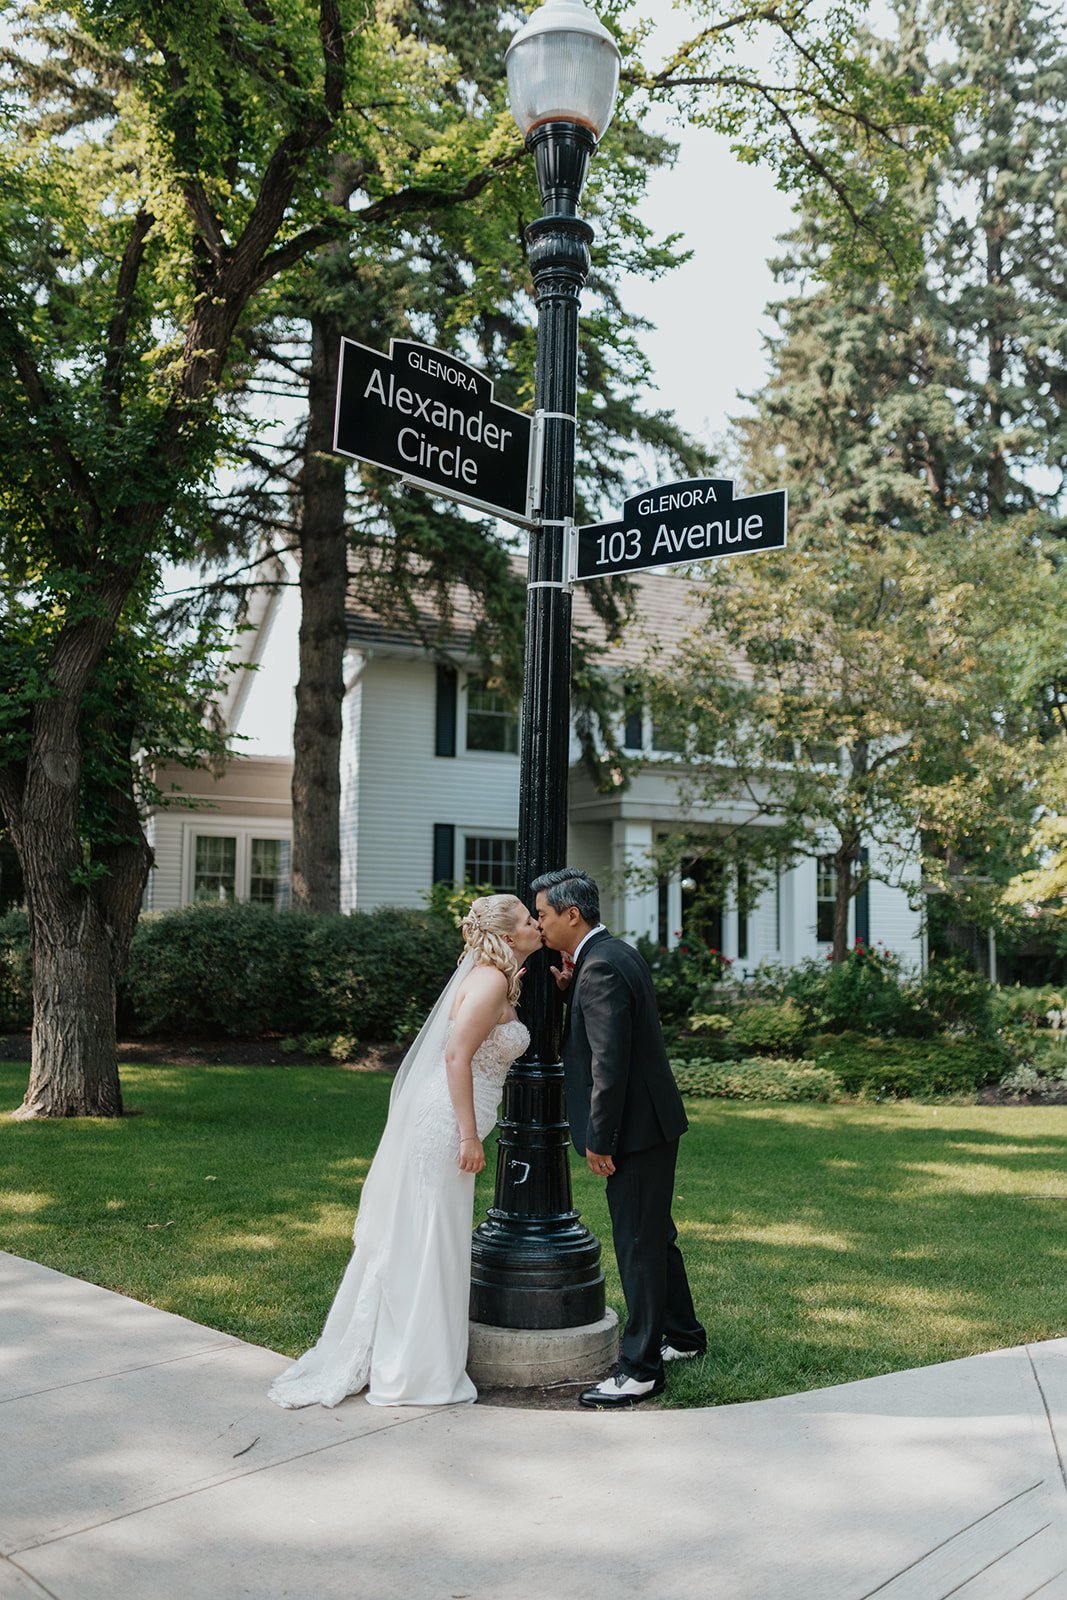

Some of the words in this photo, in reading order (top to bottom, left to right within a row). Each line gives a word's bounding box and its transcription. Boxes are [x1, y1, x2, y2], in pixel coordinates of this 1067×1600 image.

[407, 351, 478, 395] GLENORA
[363, 368, 513, 452] Alexander
[397, 427, 478, 485] Circle
[637, 486, 718, 516] GLENORA
[595, 528, 642, 565] 103
[651, 514, 764, 556] Avenue
